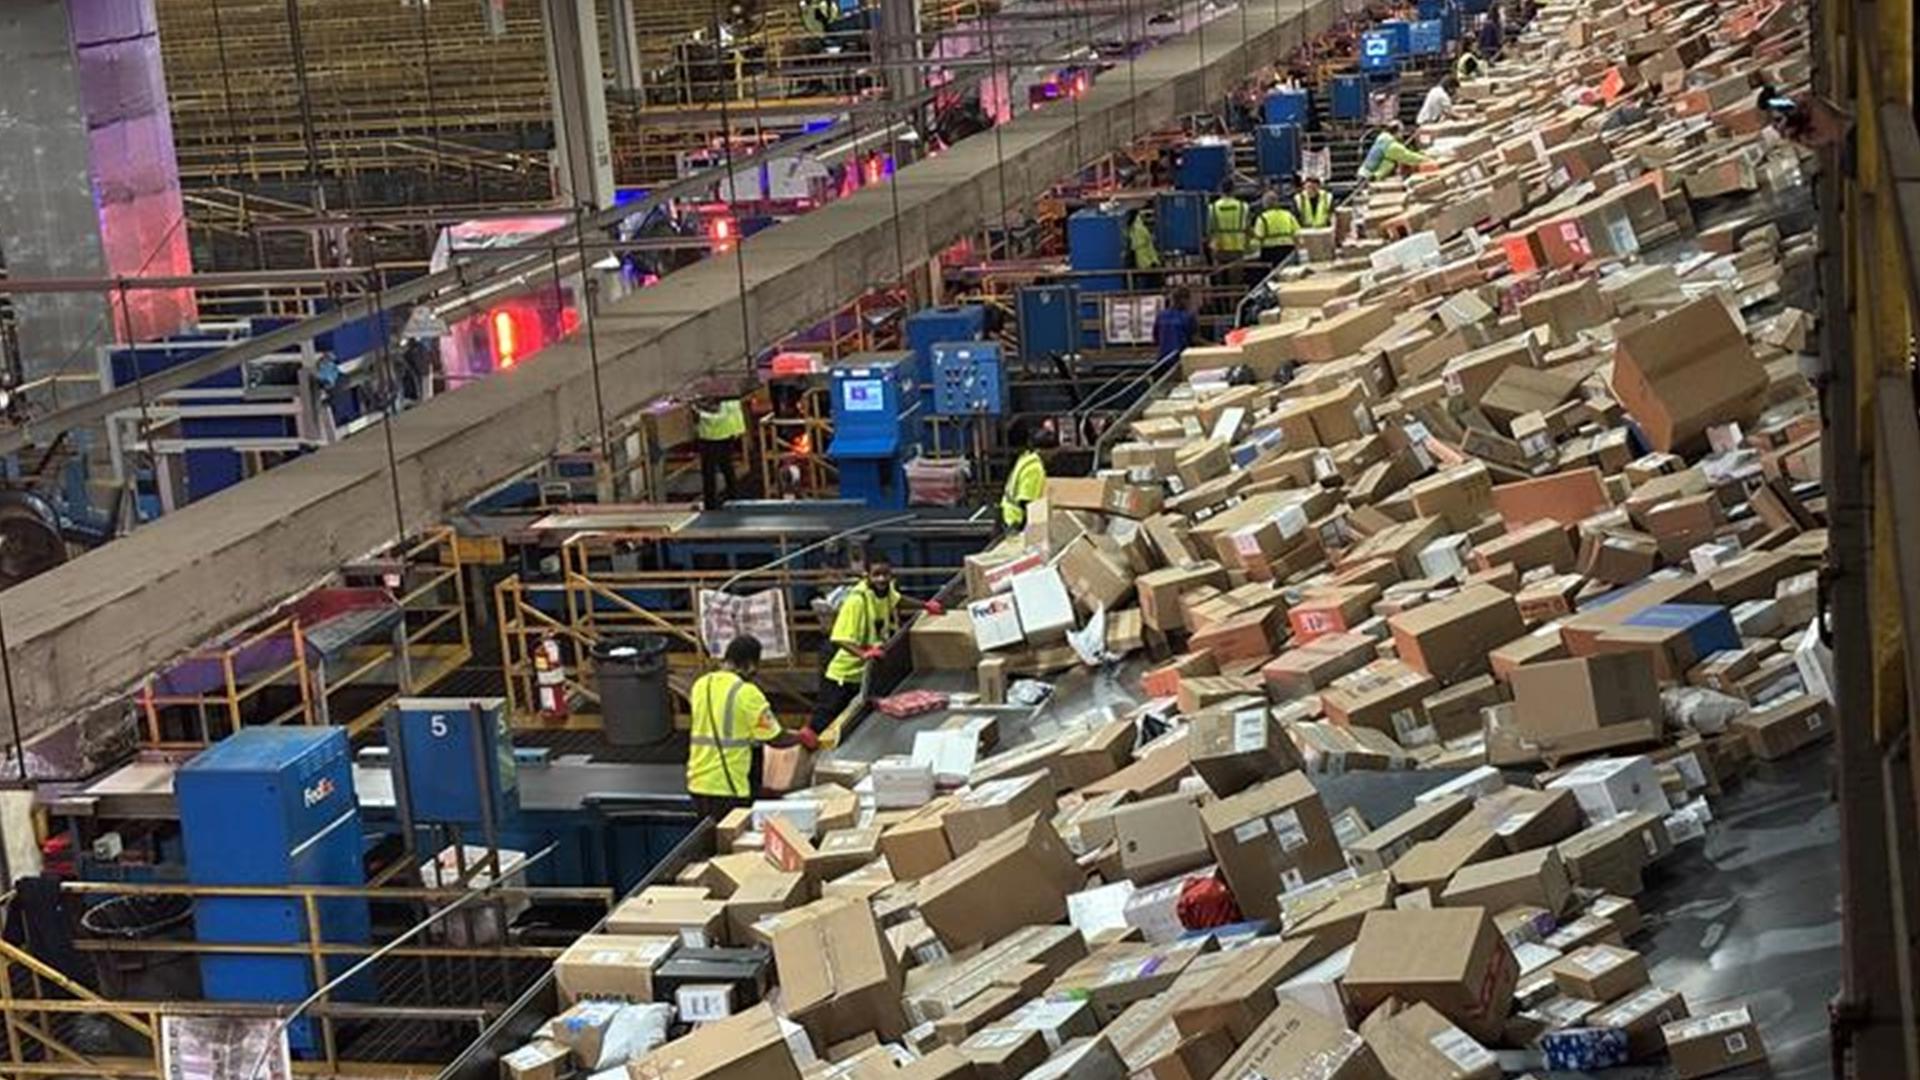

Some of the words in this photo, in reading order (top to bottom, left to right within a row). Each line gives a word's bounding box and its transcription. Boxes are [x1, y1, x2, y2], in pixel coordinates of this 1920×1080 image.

[971, 601, 1009, 619] FedEx
[431, 714, 448, 737] 5
[303, 777, 336, 808] FedEx
